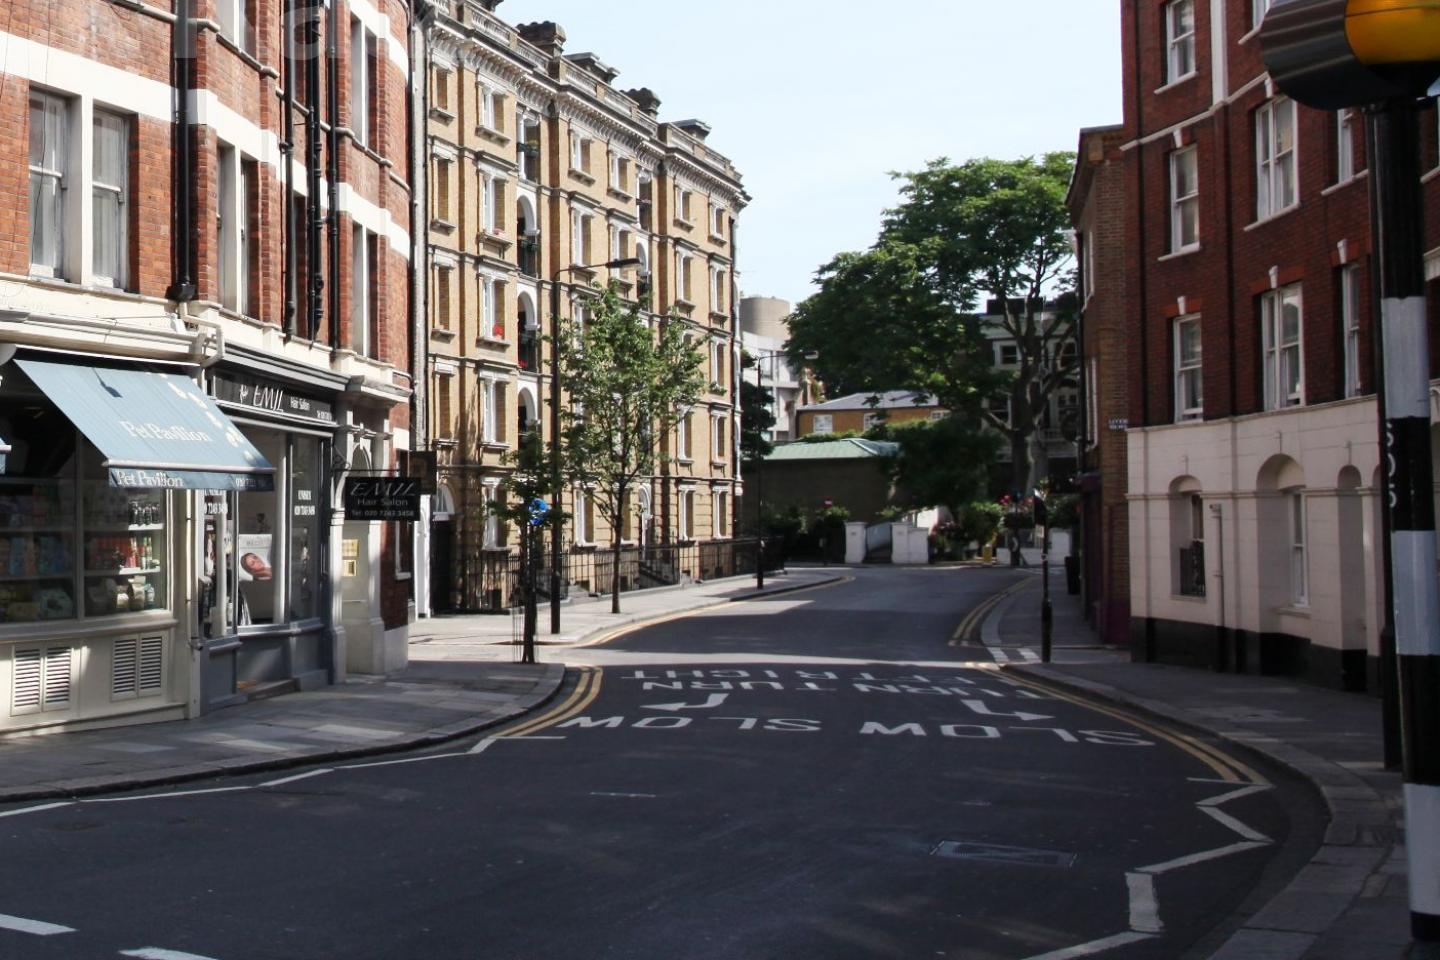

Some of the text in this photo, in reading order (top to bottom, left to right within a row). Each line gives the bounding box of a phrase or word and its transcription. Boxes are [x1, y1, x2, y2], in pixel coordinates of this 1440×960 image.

[121, 419, 210, 444] Pet Pavilion
[116, 471, 137, 487] Pet
[137, 472, 184, 488] Pavilion
[350, 482, 417, 496] EMIL
[381, 498, 408, 506] Salon
[860, 720, 1155, 747] SLOW
